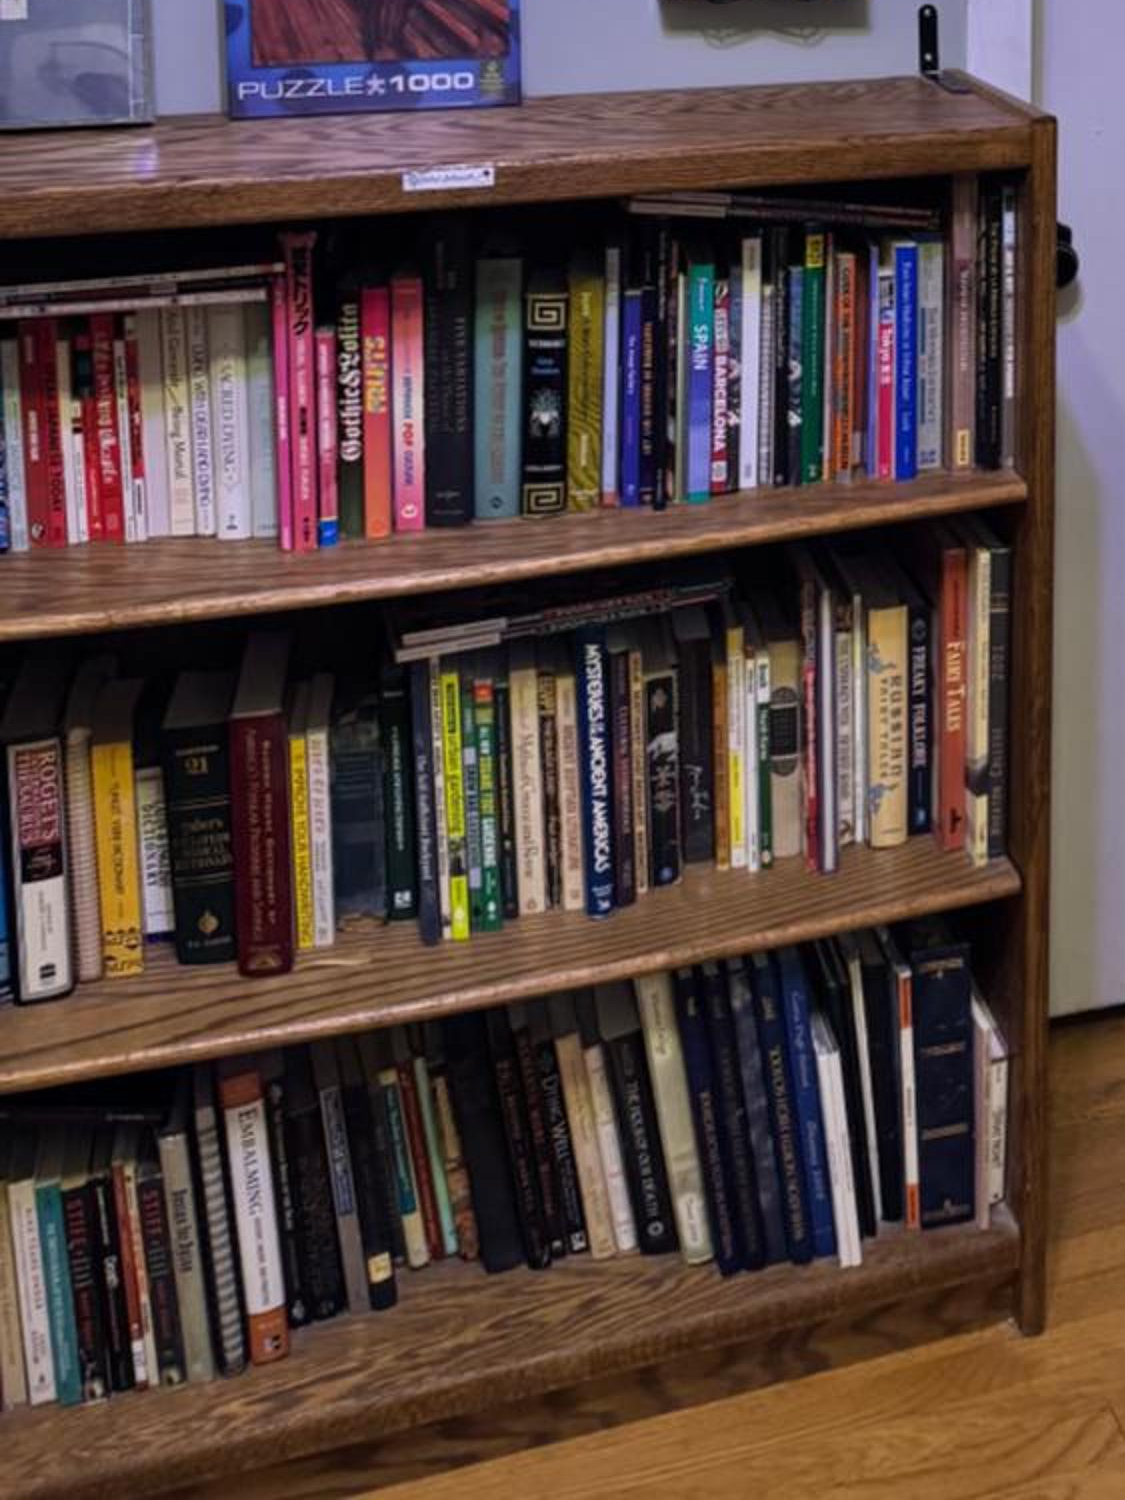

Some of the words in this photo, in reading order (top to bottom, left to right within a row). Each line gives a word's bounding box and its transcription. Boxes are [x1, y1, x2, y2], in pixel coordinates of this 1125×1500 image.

[237, 76, 366, 101] PUZZLE
[389, 72, 475, 94] 1000
[693, 323, 708, 371] SPAIN
[713, 355, 728, 453] BARCELONA
[222, 423, 238, 473] DYING
[403, 421, 414, 447] POP
[174, 441, 189, 479] Mortal
[584, 643, 605, 722] MYSTERIES
[912, 645, 927, 697] FREAKY
[946, 640, 965, 684] FAIRY
[947, 684, 967, 734] TALES
[912, 703, 928, 769] FOLKLORE
[588, 737, 608, 797] ANCIENT
[592, 799, 611, 873] AMERICAS
[236, 1107, 263, 1217] EMBALMING
[551, 1122, 571, 1161] WELL
